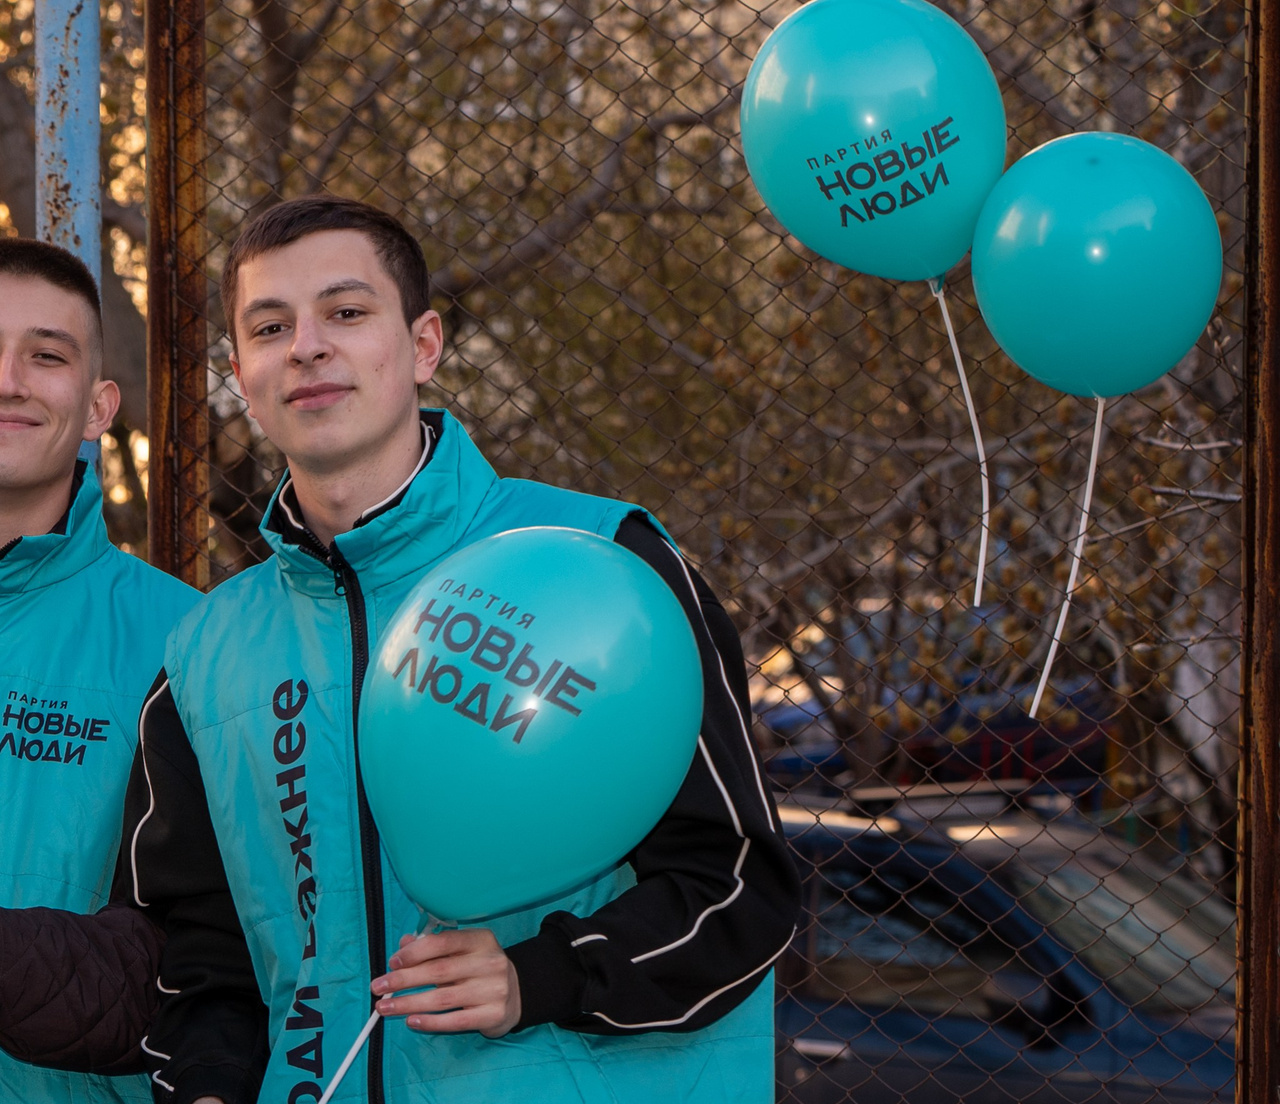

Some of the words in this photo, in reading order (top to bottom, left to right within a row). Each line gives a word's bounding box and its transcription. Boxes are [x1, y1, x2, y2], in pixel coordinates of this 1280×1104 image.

[806, 129, 892, 170] ПАРТИЯ
[815, 116, 960, 201] НОВЫЕ
[839, 162, 950, 228] ЛЮДИ
[438, 579, 536, 629] ПАРТИЯ
[413, 599, 597, 717] НОВЫЕ
[2, 704, 111, 742] НОВЫЕ
[7, 690, 68, 709] ПАРТИЯ
[392, 648, 539, 744] ЛЮДИ
